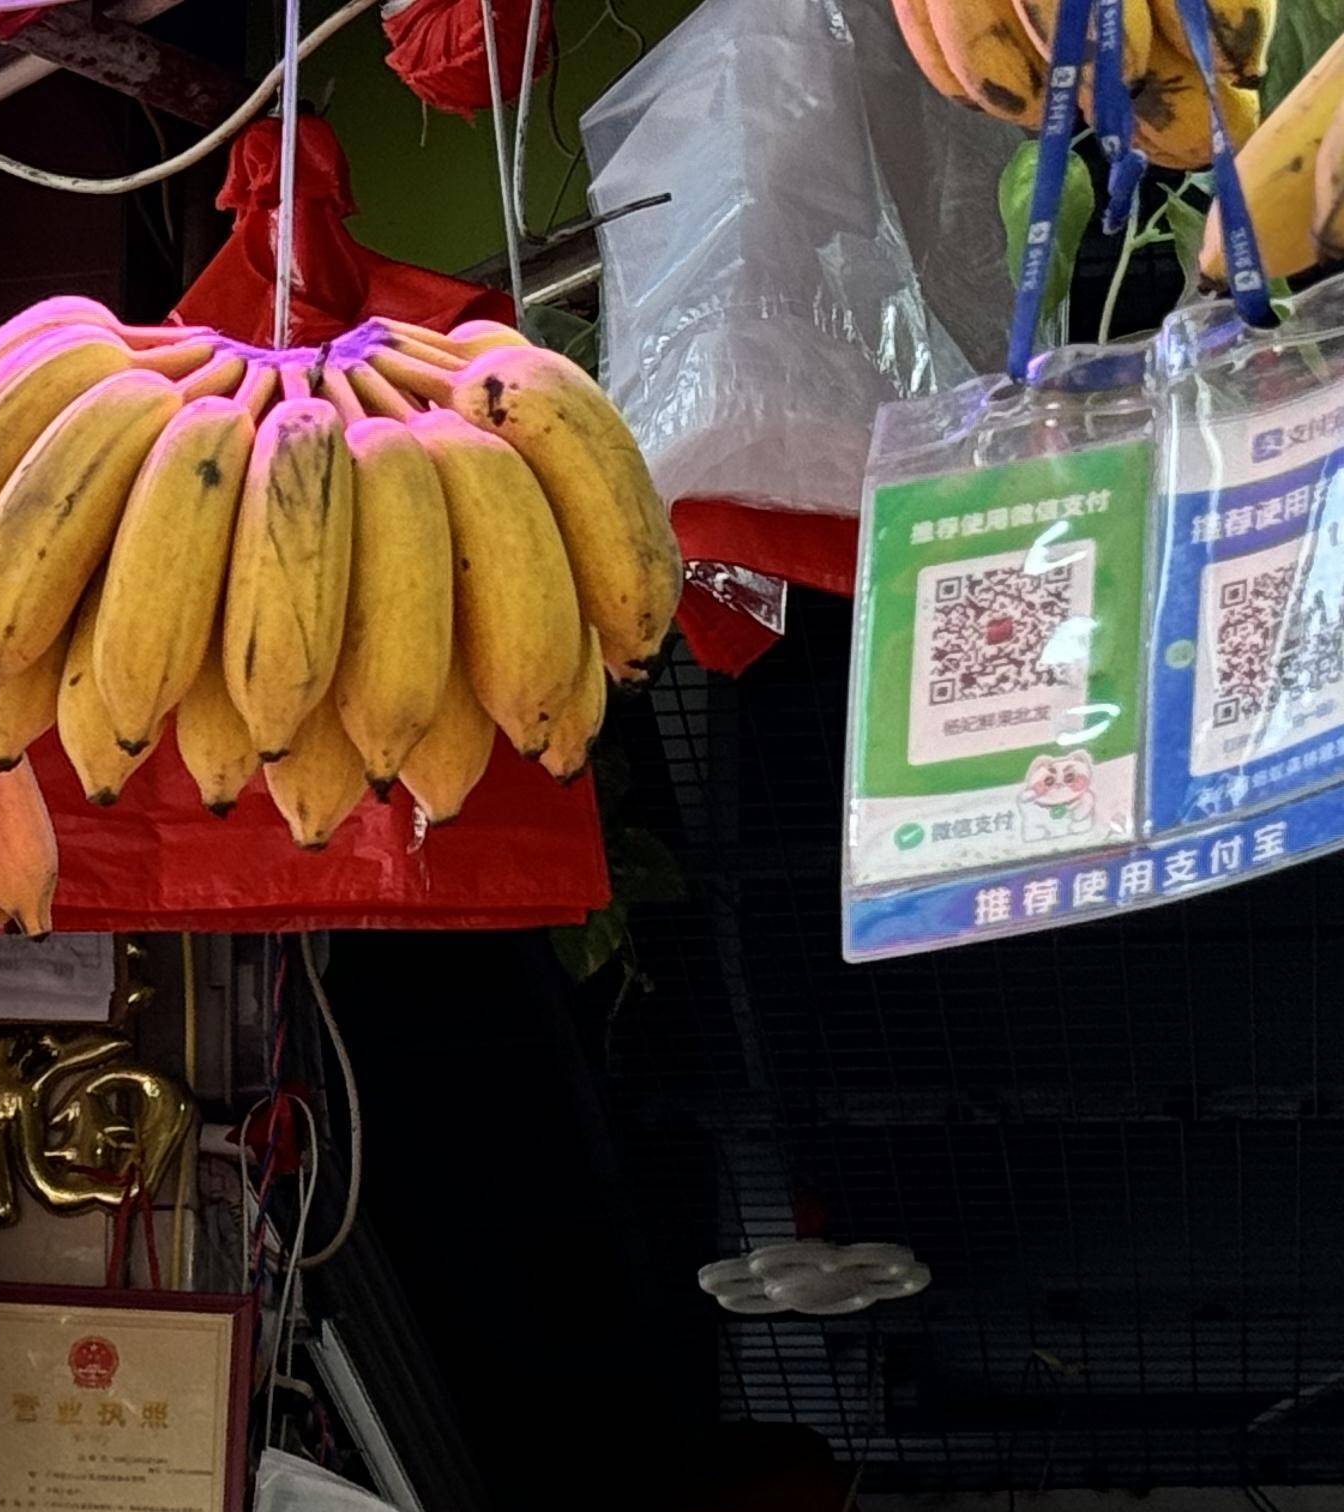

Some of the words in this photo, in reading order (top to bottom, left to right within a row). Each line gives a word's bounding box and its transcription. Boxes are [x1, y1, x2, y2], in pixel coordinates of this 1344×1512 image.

[910, 489, 1112, 546] 推荐使用微信支付
[930, 808, 1015, 844] 微信支付
[974, 820, 1289, 926] 推荐使用支付宝
[13, 1392, 171, 1430] 营业执照
